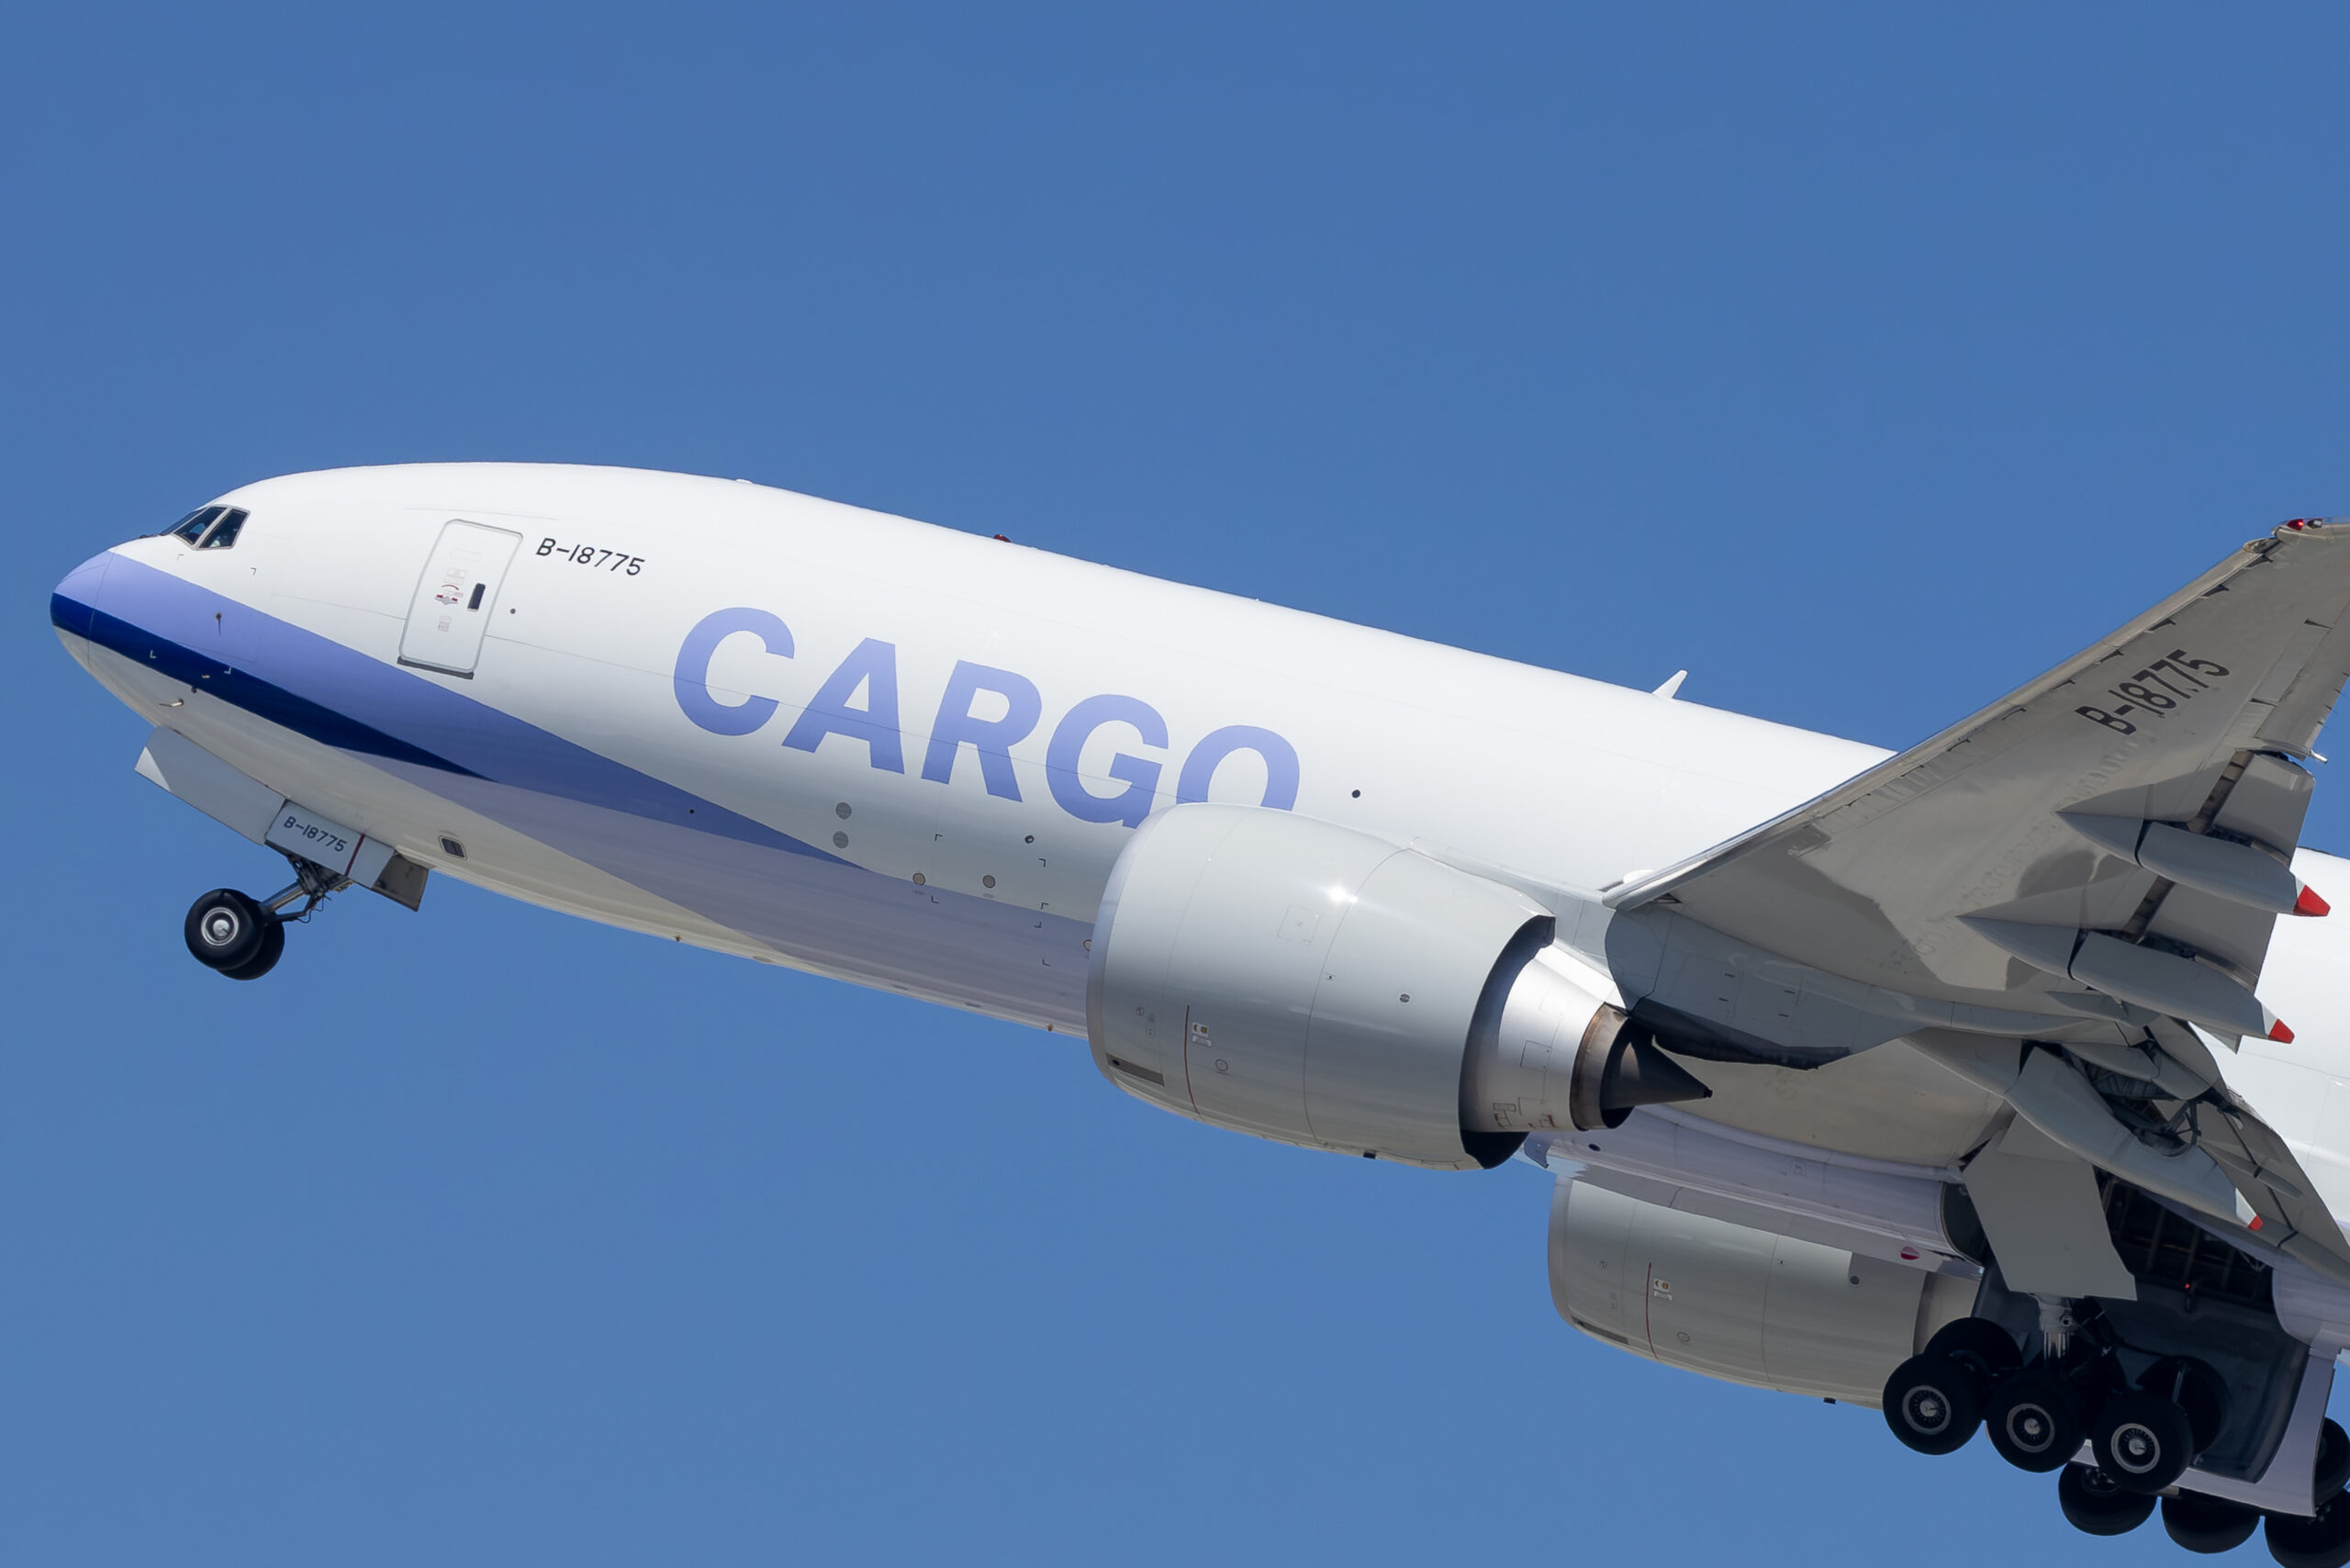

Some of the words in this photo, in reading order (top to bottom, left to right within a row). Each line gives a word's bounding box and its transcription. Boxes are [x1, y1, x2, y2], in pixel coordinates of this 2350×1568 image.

[535, 537, 645, 576] B-18775
[673, 607, 1301, 829] CARGO
[2074, 648, 2230, 735] B-18775
[284, 815, 348, 852] B-18775
